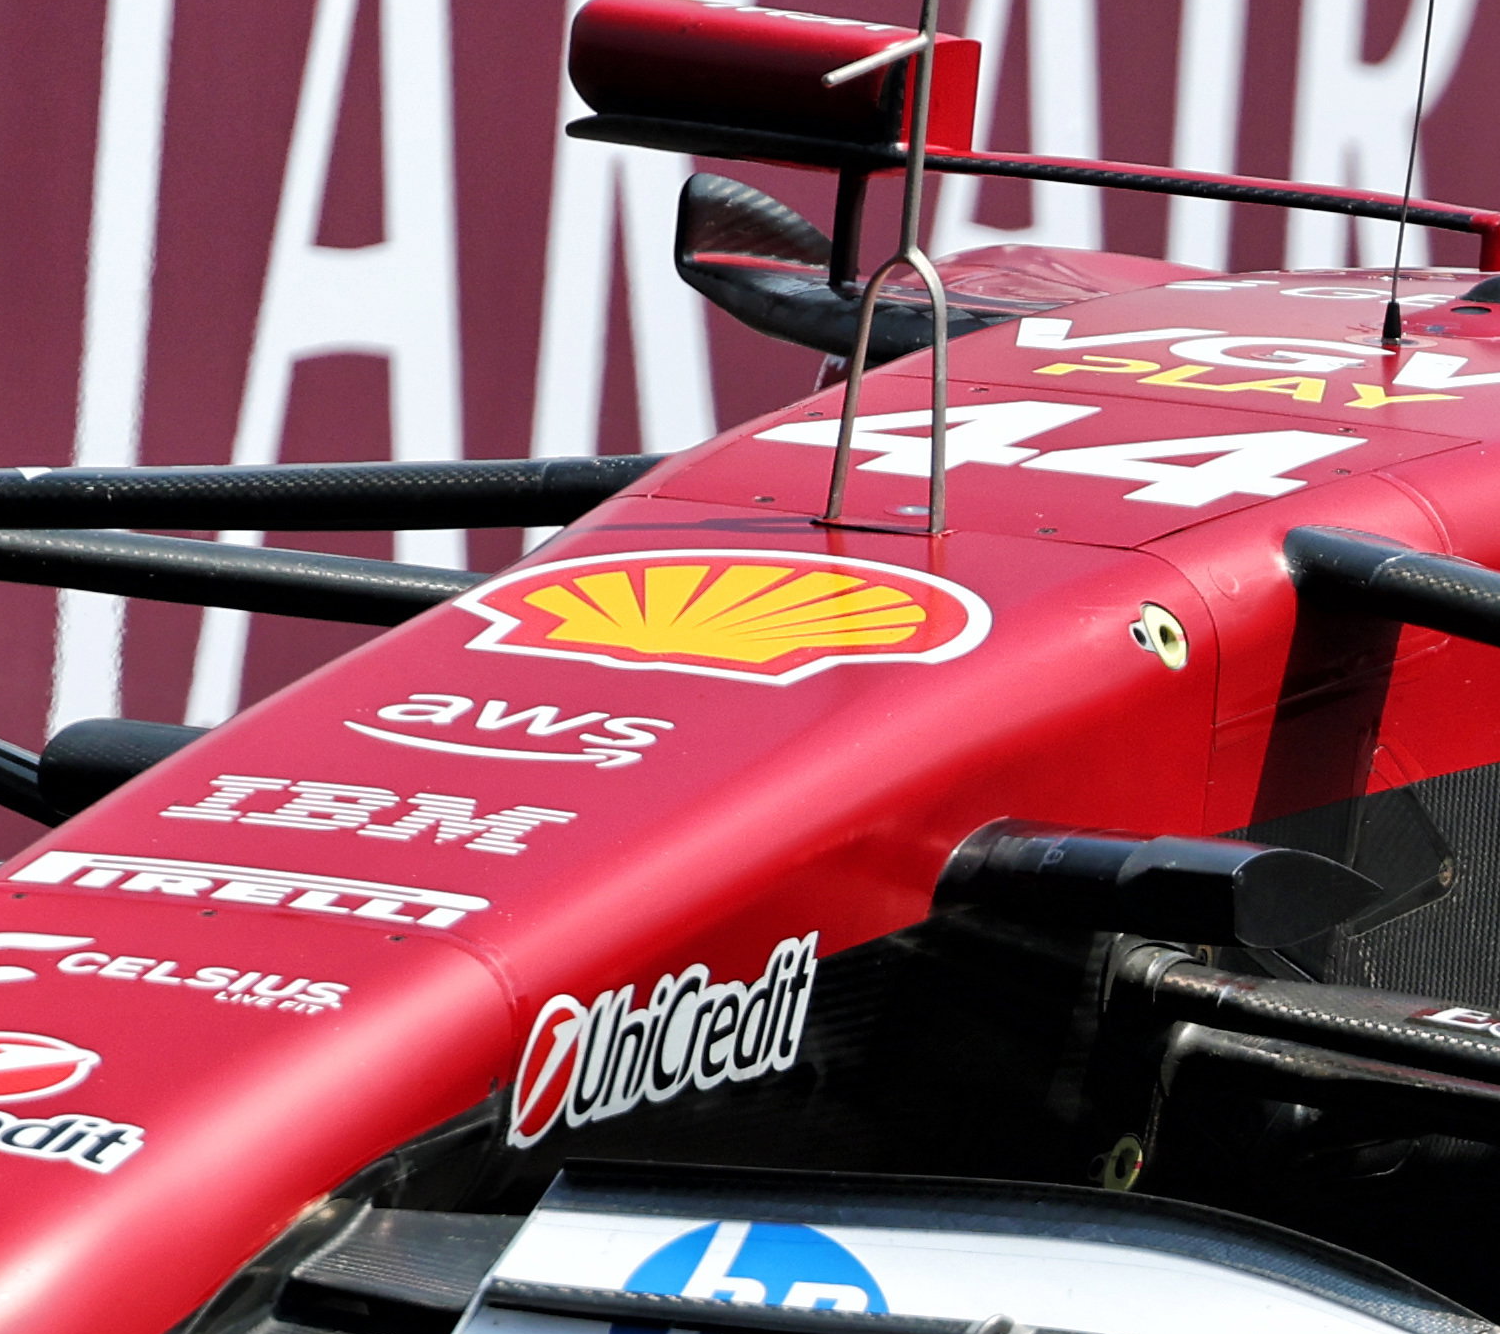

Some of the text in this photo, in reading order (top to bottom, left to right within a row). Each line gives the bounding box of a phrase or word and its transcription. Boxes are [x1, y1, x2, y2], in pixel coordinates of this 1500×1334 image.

[1033, 354, 1464, 409] PLAY
[753, 400, 1368, 508] 44
[377, 693, 675, 750] aws
[159, 775, 578, 856] IBM
[7, 850, 492, 930] PIRELLI
[56, 951, 352, 1009] CELSIUS
[214, 989, 325, 1016] LIVE FIT
[570, 933, 817, 1127] UniCredit
